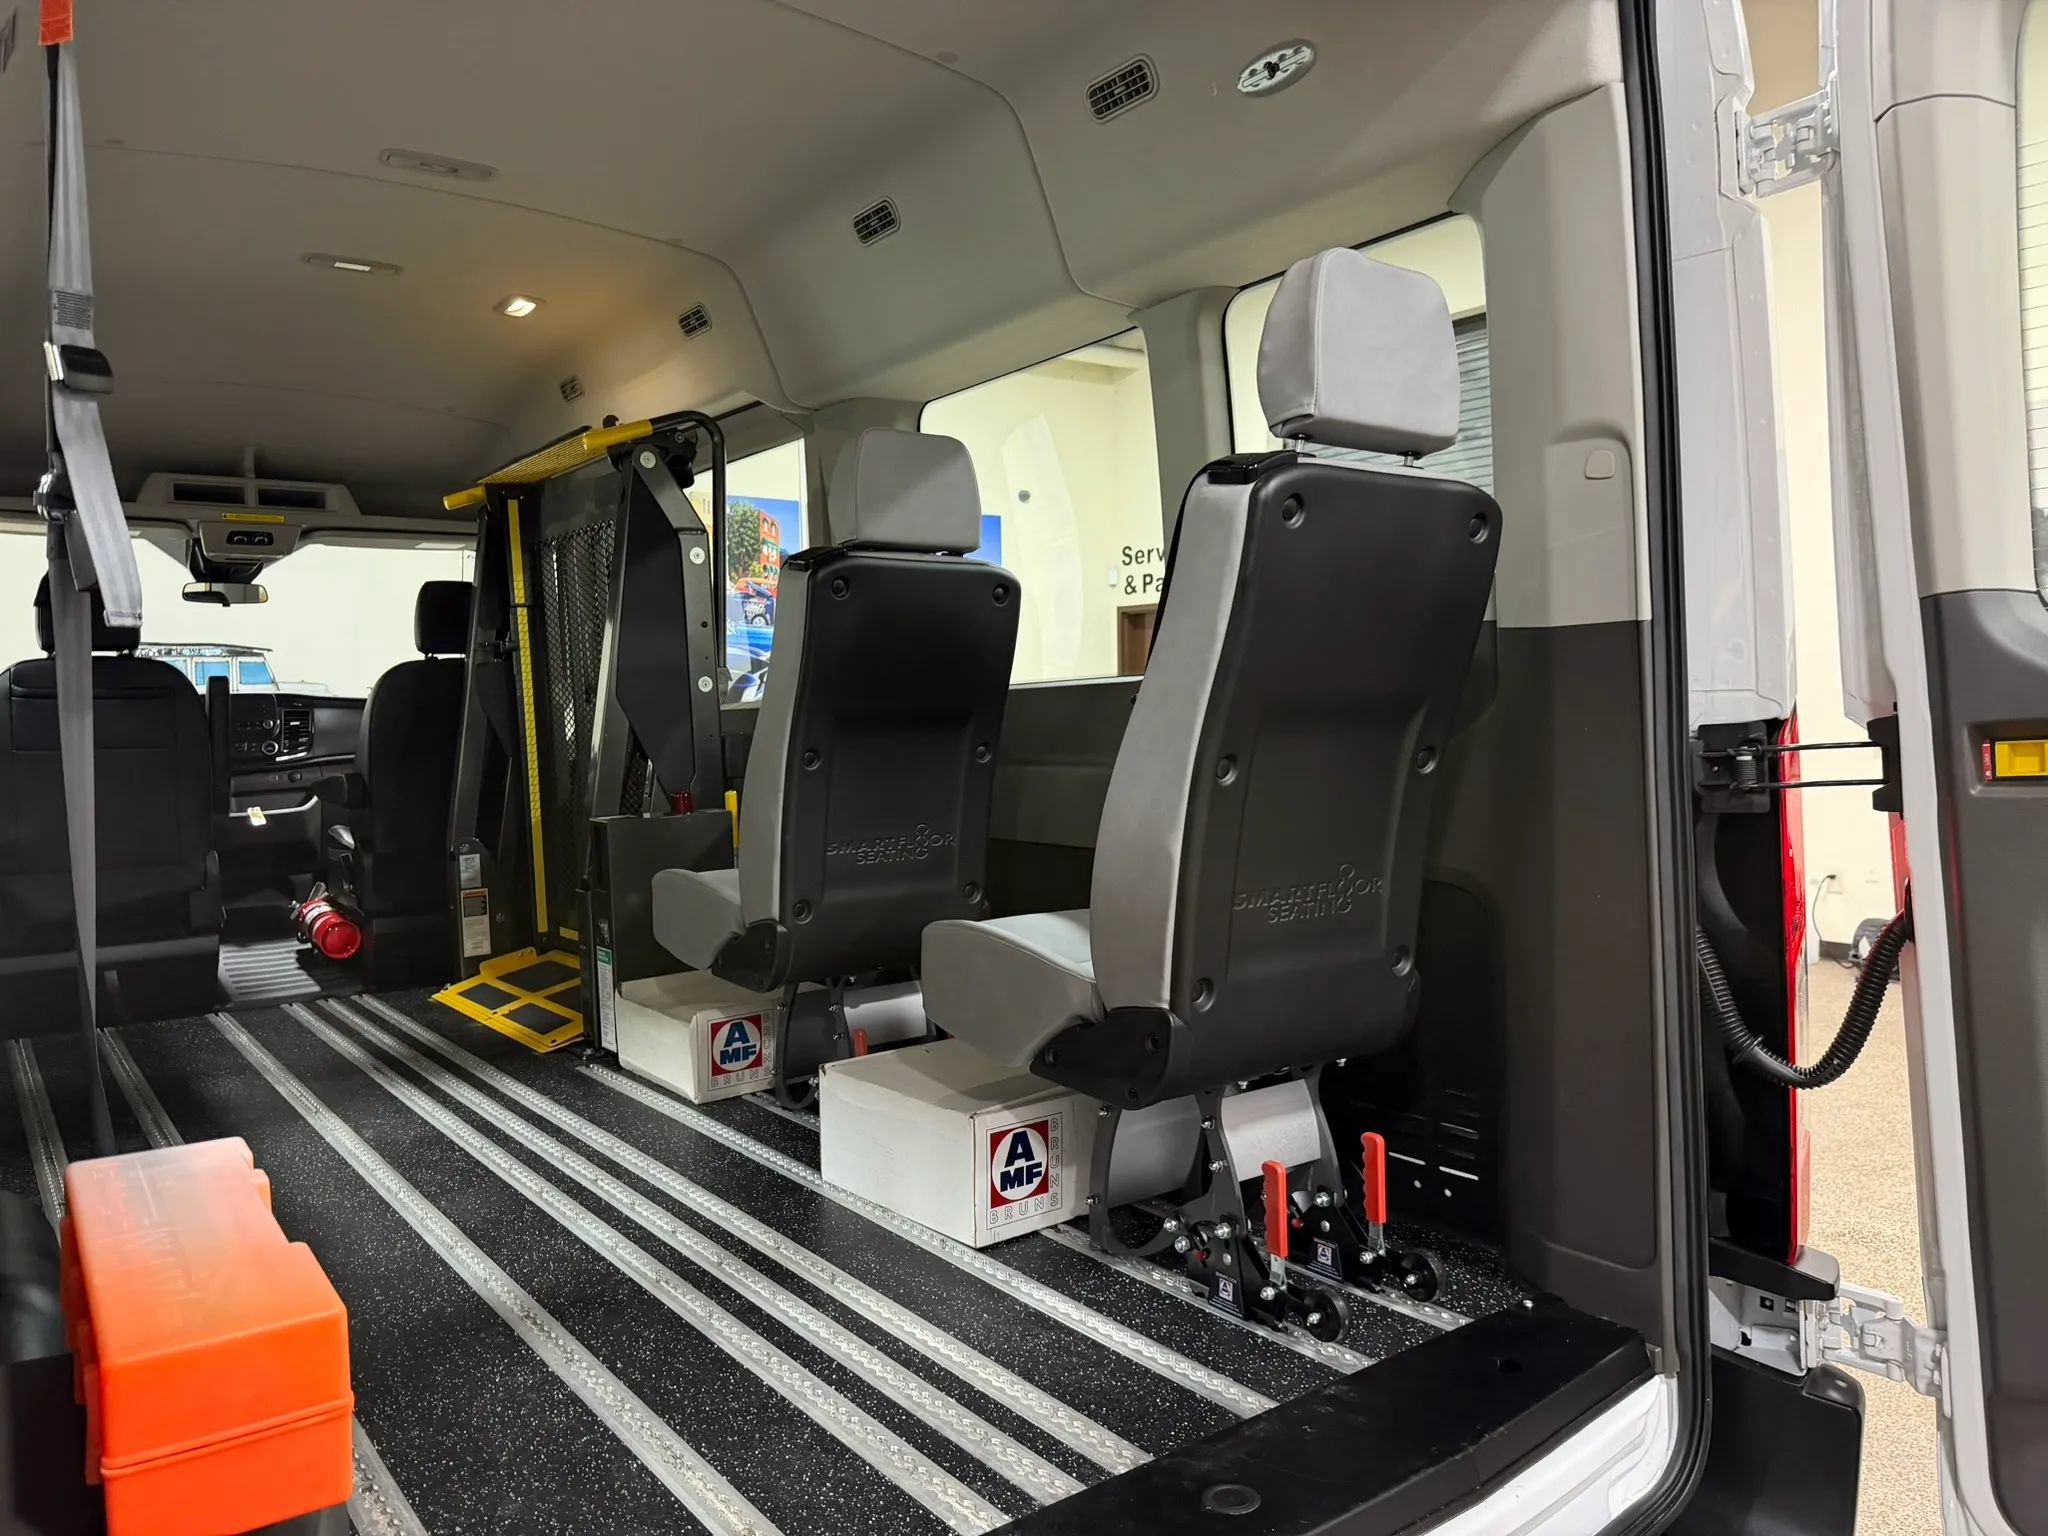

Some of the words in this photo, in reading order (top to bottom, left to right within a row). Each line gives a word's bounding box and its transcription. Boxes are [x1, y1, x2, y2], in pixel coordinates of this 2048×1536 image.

[1122, 545, 1164, 566] Serv
[1124, 574, 1137, 595] &
[856, 847, 929, 865] SEATING
[1268, 895, 1352, 924] SEATING
[1050, 1118, 1060, 1207] BRUNS
[990, 1193, 1059, 1225] BRUNS
